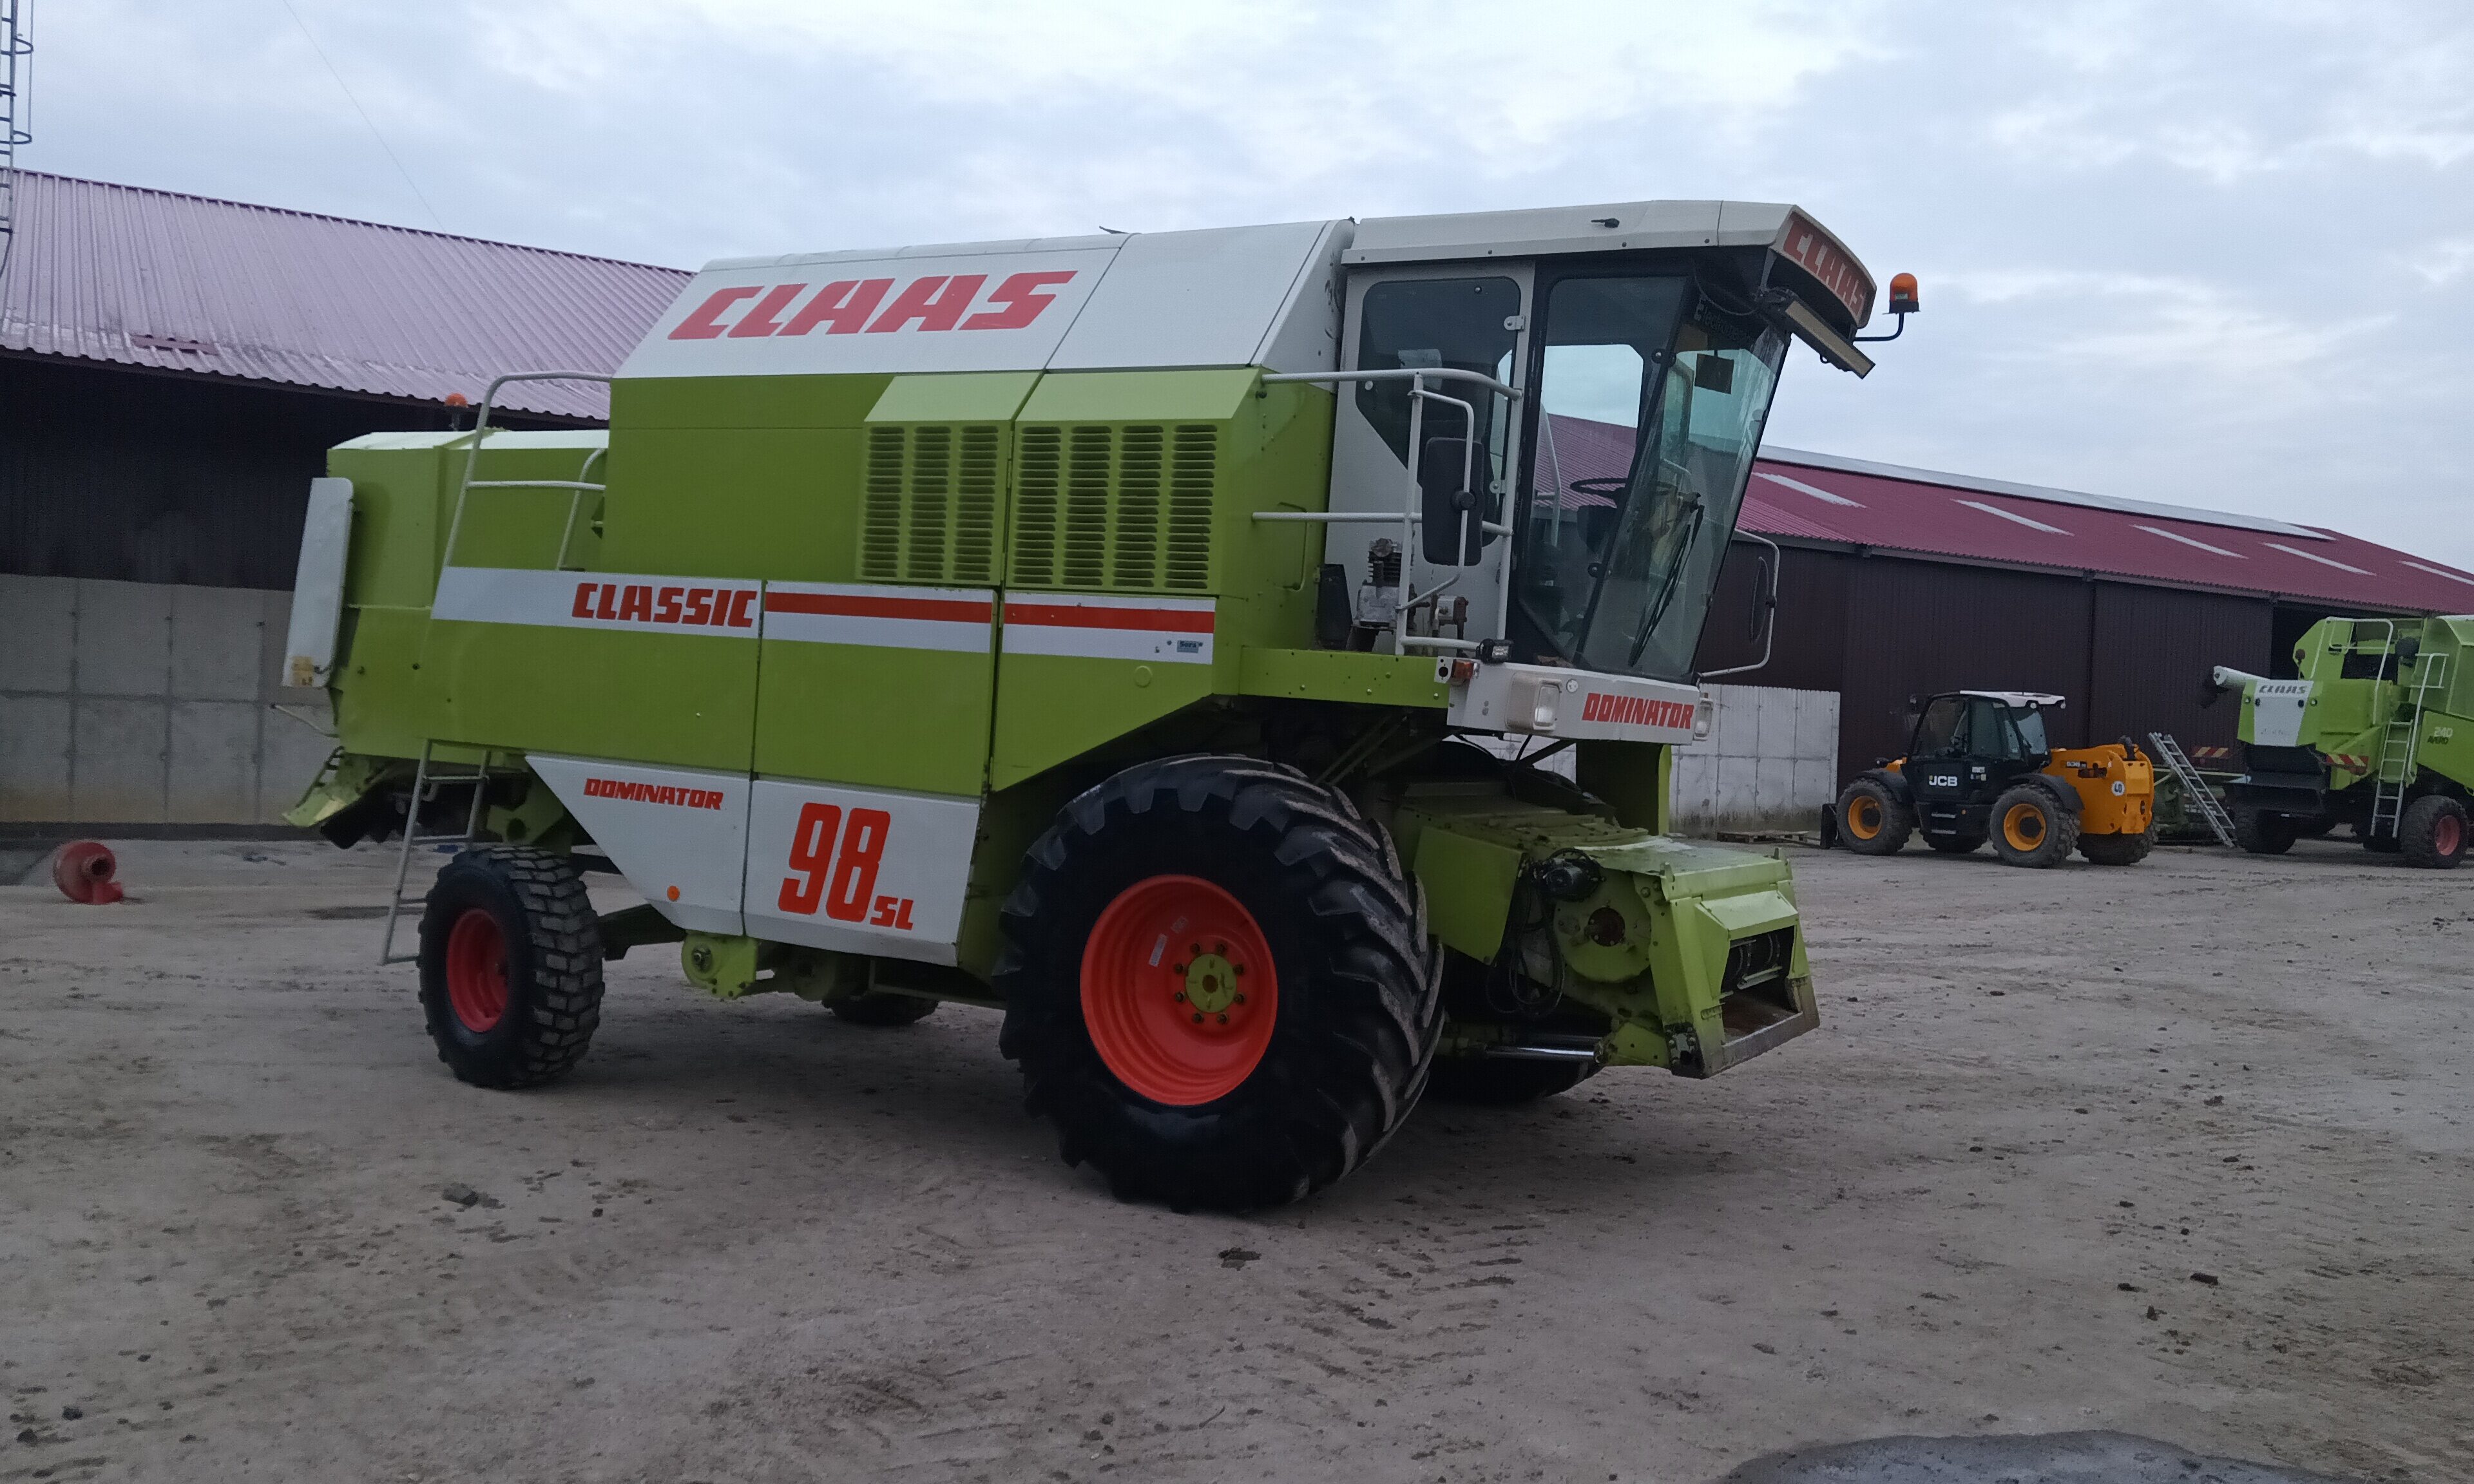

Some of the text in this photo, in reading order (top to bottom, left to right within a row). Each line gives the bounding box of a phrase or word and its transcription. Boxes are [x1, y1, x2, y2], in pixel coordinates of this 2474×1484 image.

[1783, 213, 1866, 318] CLAAS
[667, 271, 1079, 340] CLAAS
[571, 583, 757, 628] CLASSIC
[2259, 685, 2307, 694] CLAAS
[1582, 692, 1694, 730] DOMINATOR
[2433, 726, 2453, 737] 240
[584, 778, 724, 810] DOMINATOR
[1928, 775, 1958, 786] JCB
[2114, 783, 2123, 794] 40
[778, 802, 914, 930] 98 SL
